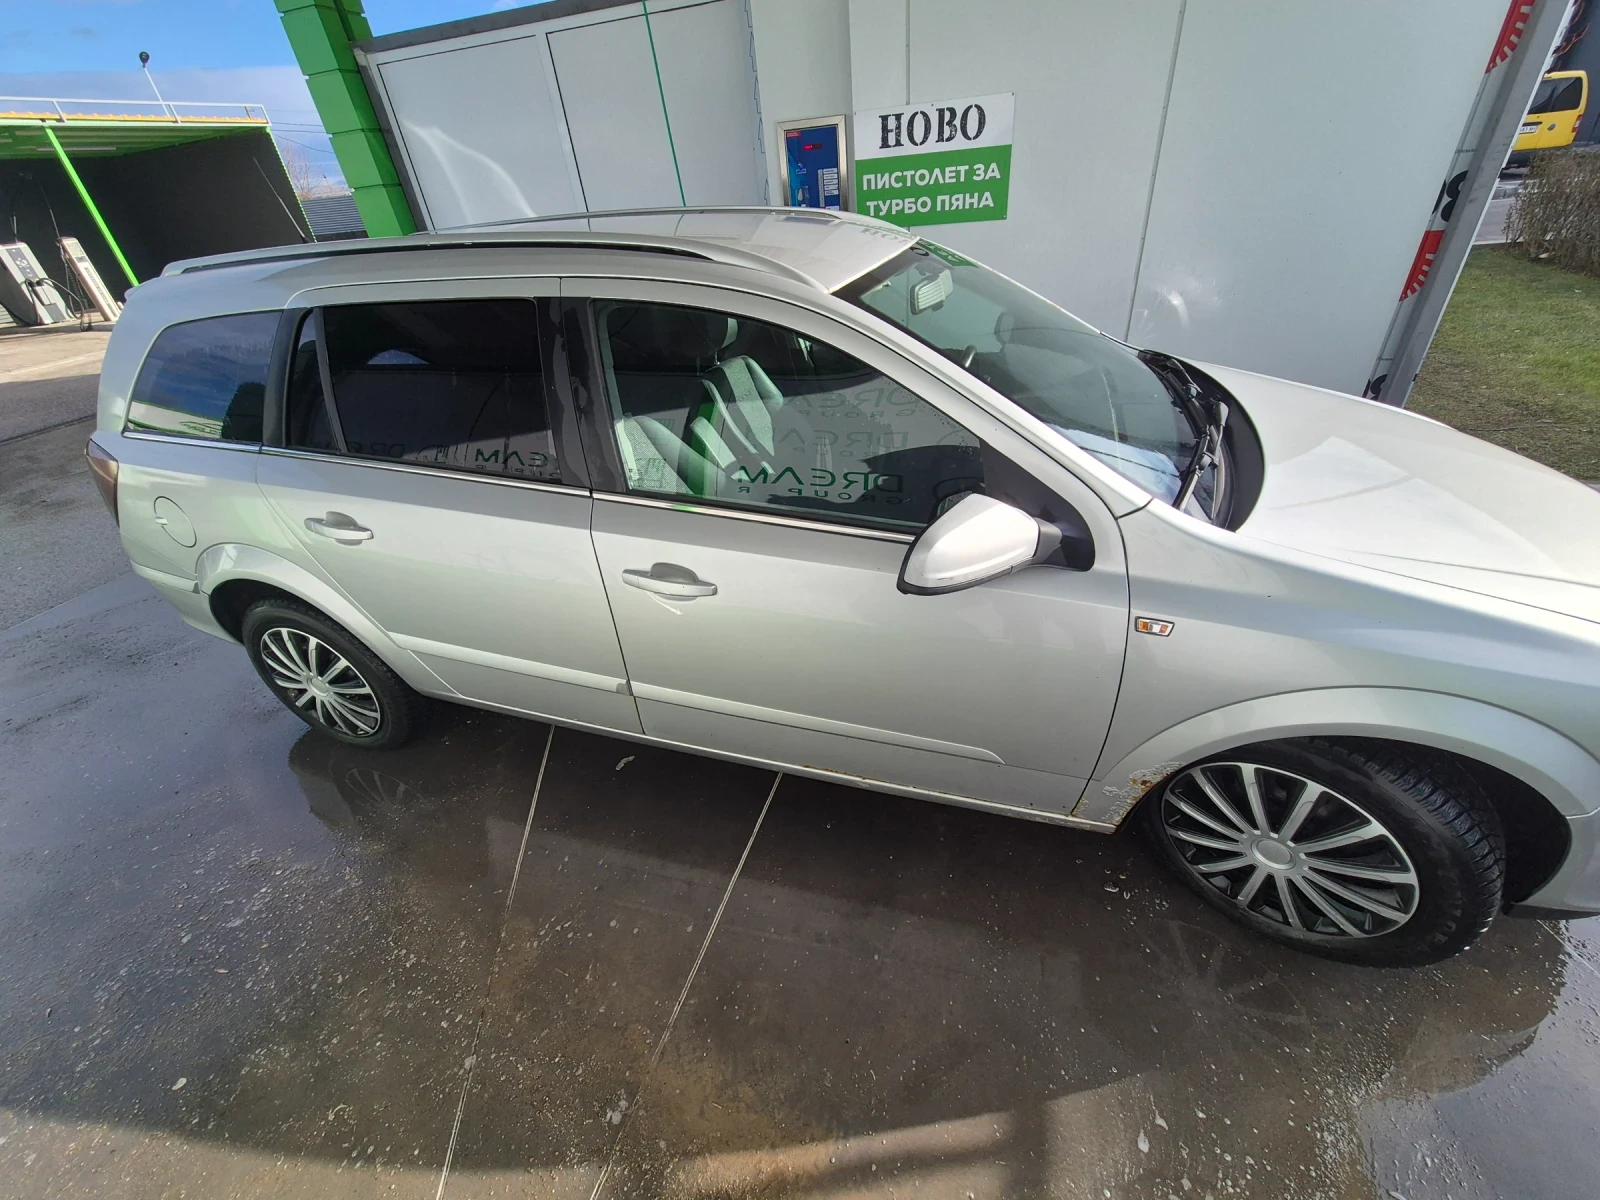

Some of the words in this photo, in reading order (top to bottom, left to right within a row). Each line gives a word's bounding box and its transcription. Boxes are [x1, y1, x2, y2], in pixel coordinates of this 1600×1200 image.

[878, 104, 987, 149] НОВО
[862, 165, 969, 190] ПИСТОЛЕТ
[972, 162, 1001, 181] ЗА
[866, 199, 932, 217] ТУРБО
[936, 191, 995, 211] ПЯНА
